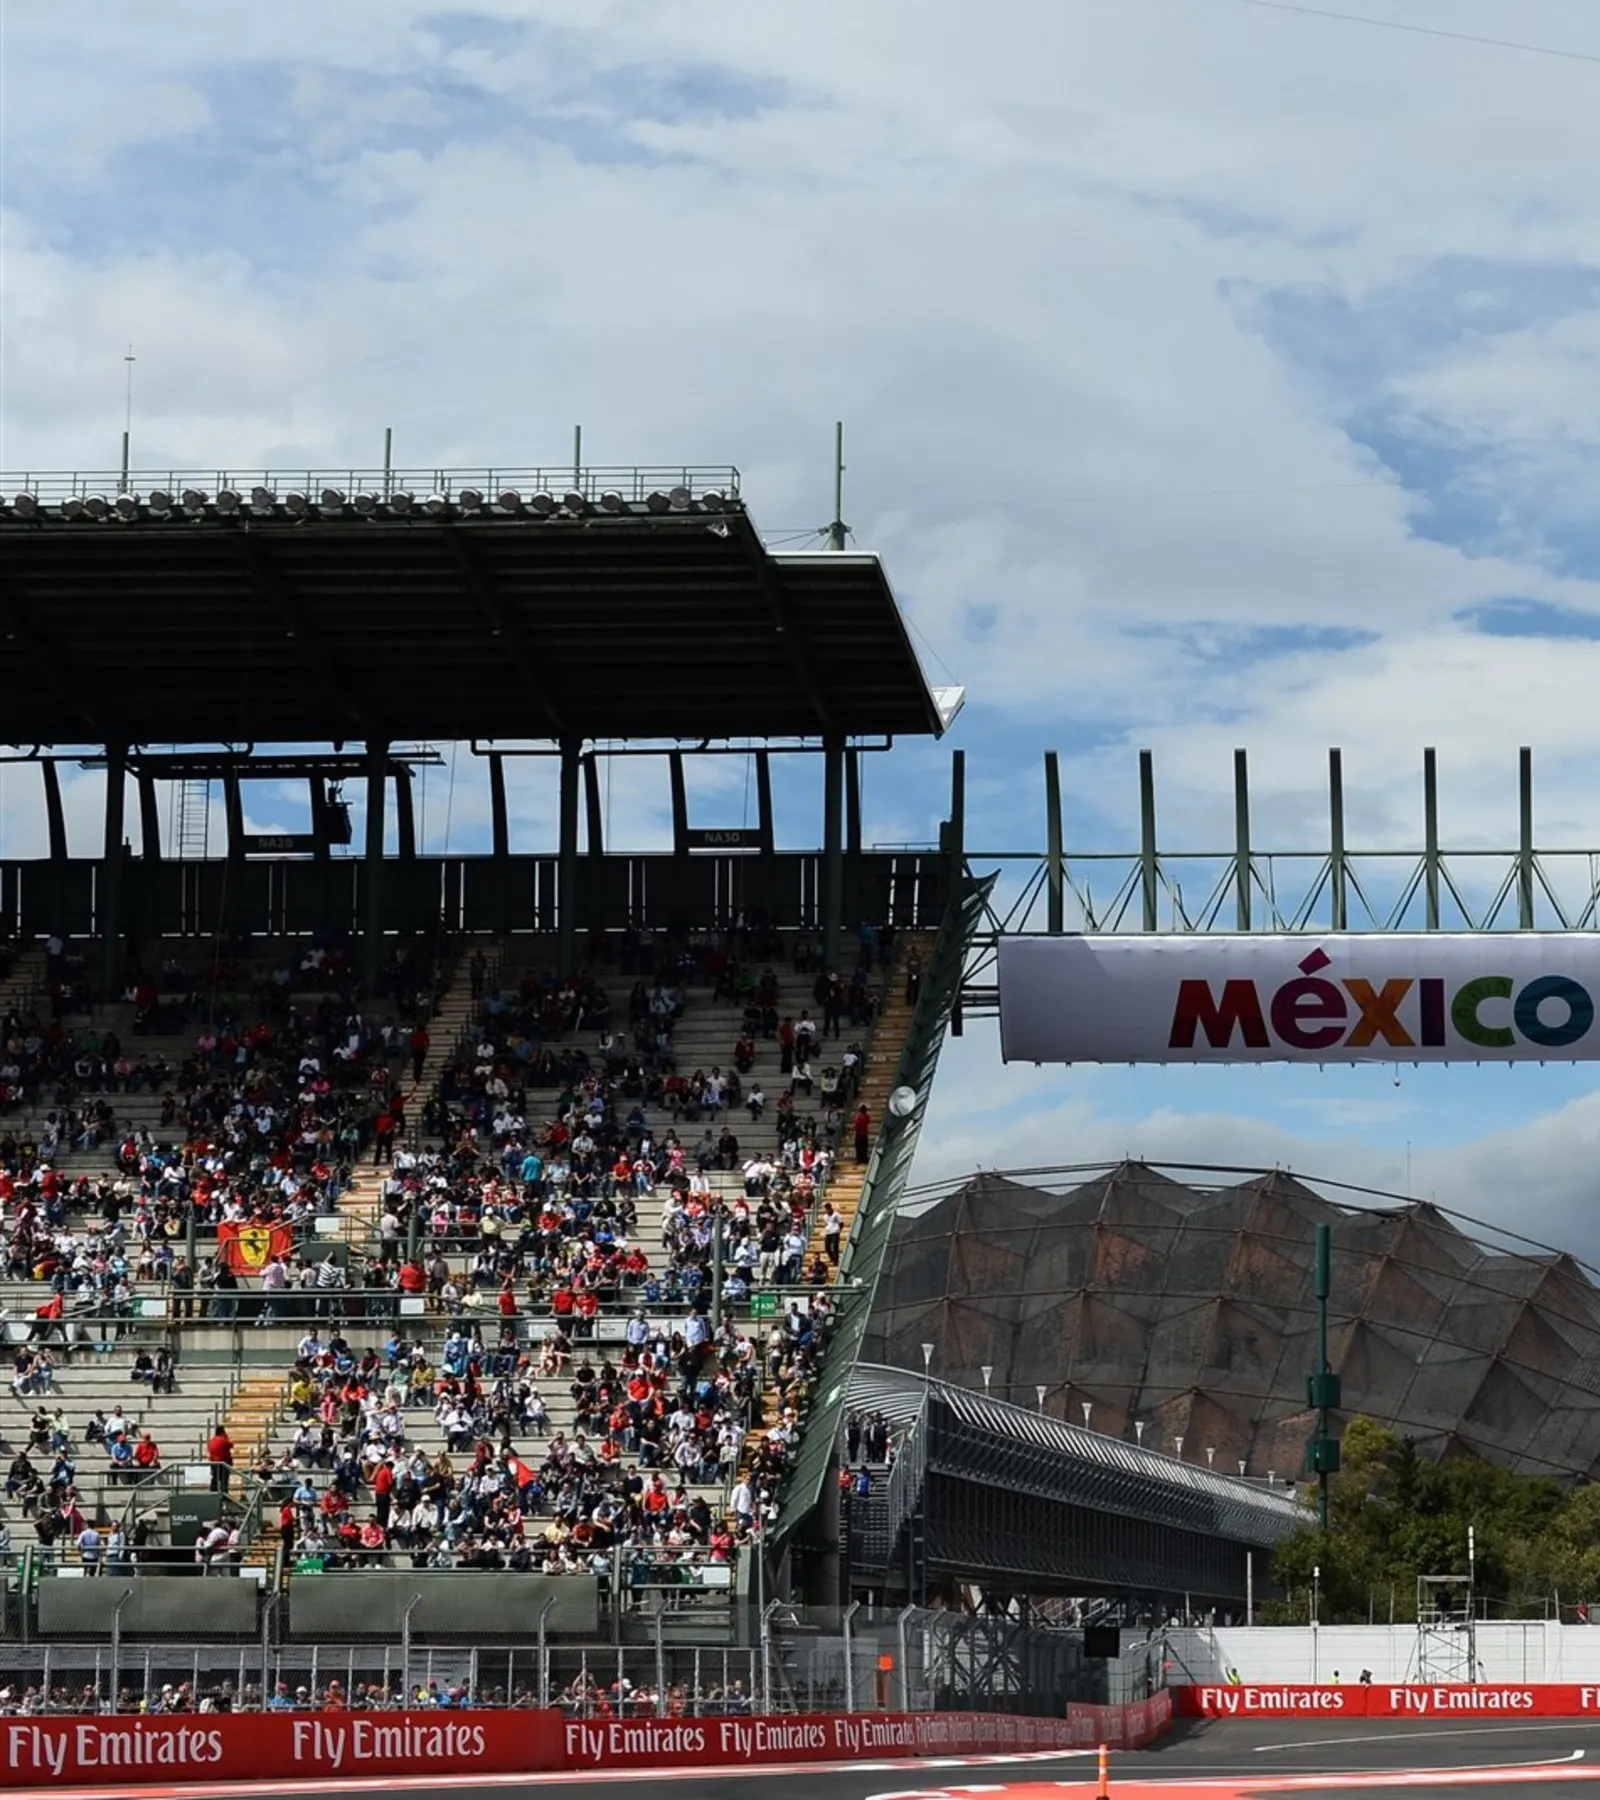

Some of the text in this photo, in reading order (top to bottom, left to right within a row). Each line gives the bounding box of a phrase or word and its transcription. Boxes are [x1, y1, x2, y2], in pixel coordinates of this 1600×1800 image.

[1201, 1686, 1344, 1713] Fly Emirates
[1390, 1686, 1533, 1713] Fly Emirates
[9, 1722, 224, 1776] Fly Emirates
[293, 1717, 486, 1768] Fly Emirates
[565, 1721, 706, 1761] Fly Emirates
[720, 1718, 826, 1758] Fly Emirates
[834, 1719, 860, 1754] Fly
